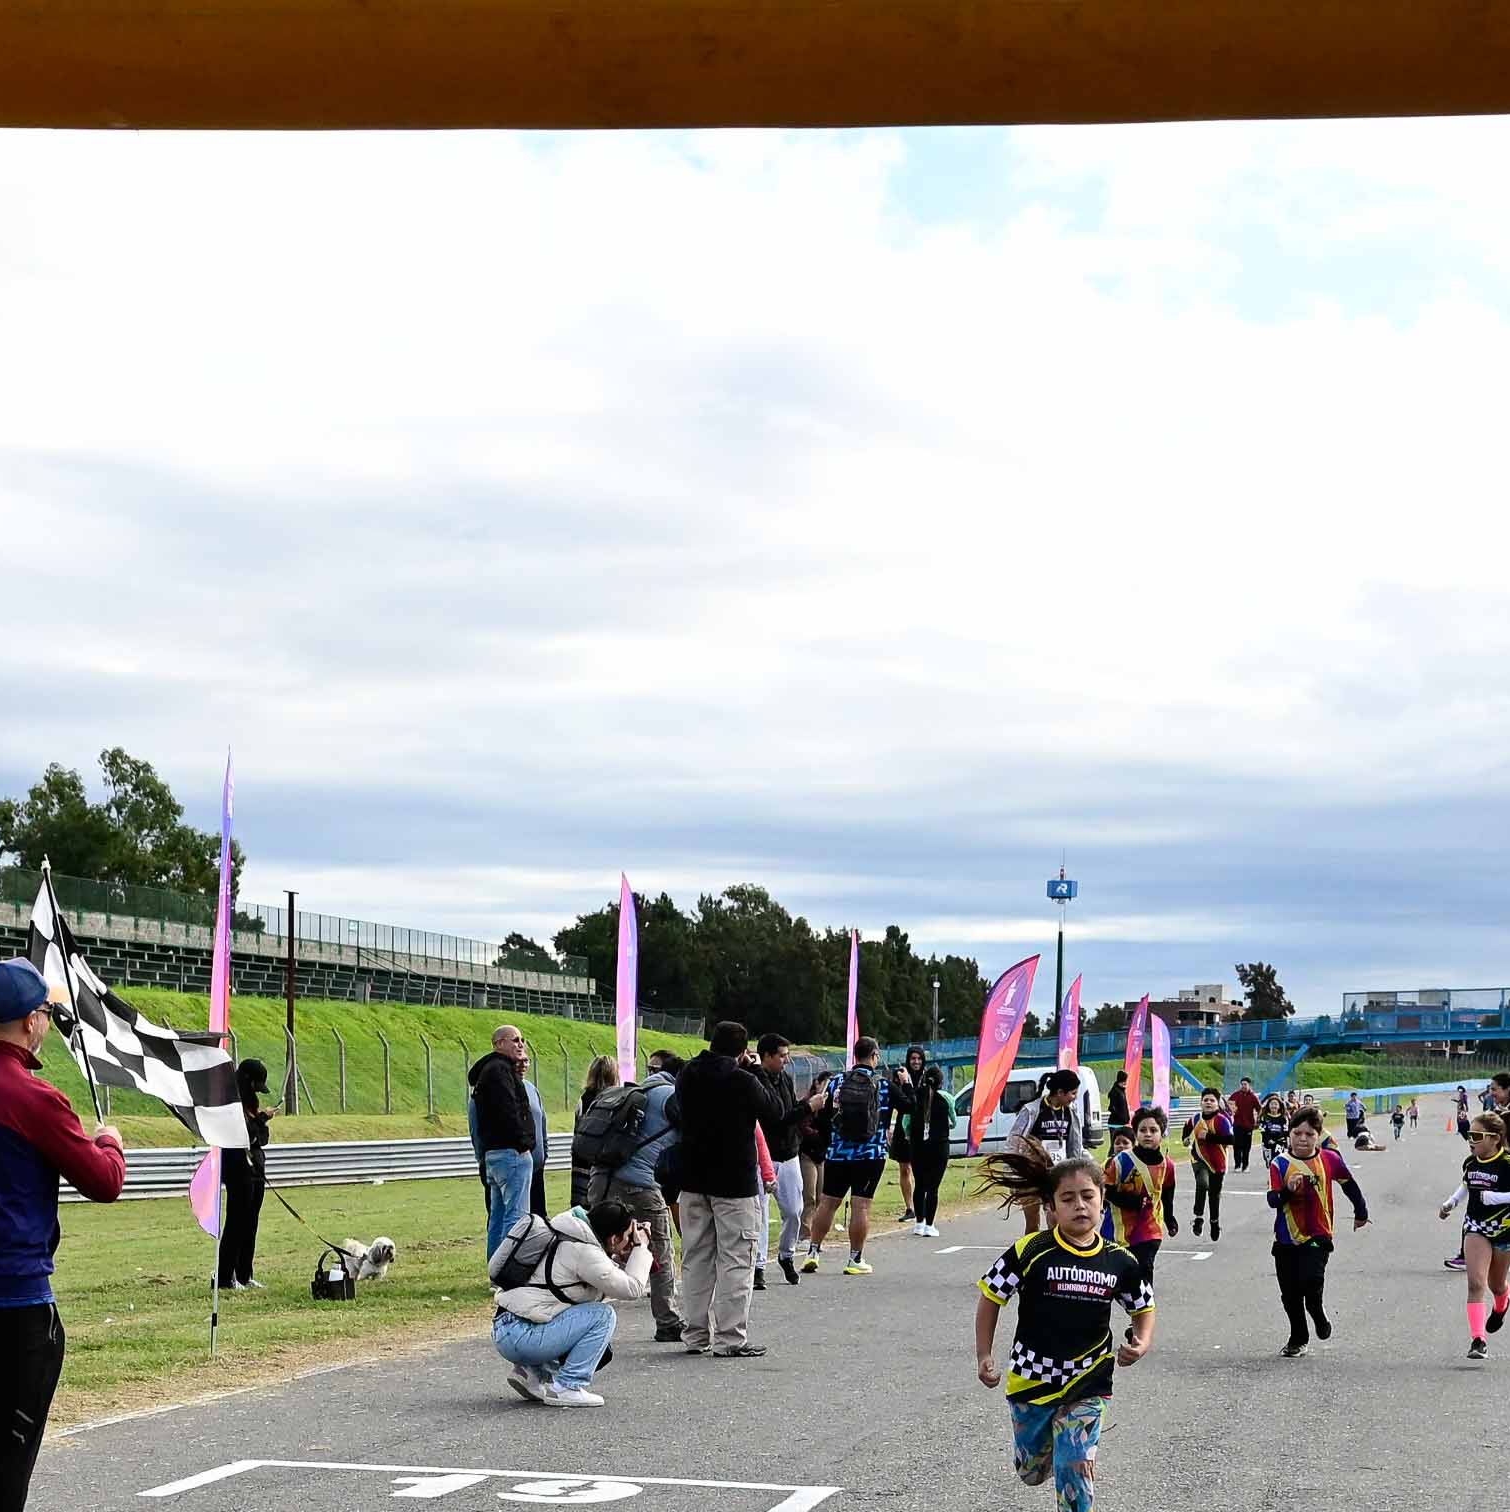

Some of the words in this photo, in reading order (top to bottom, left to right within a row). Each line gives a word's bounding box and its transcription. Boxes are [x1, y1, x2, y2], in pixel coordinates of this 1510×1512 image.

[1046, 1265, 1118, 1289] AUTÓDROMO
[1089, 1285, 1107, 1296] RACE
[390, 1474, 643, 1504] 19
